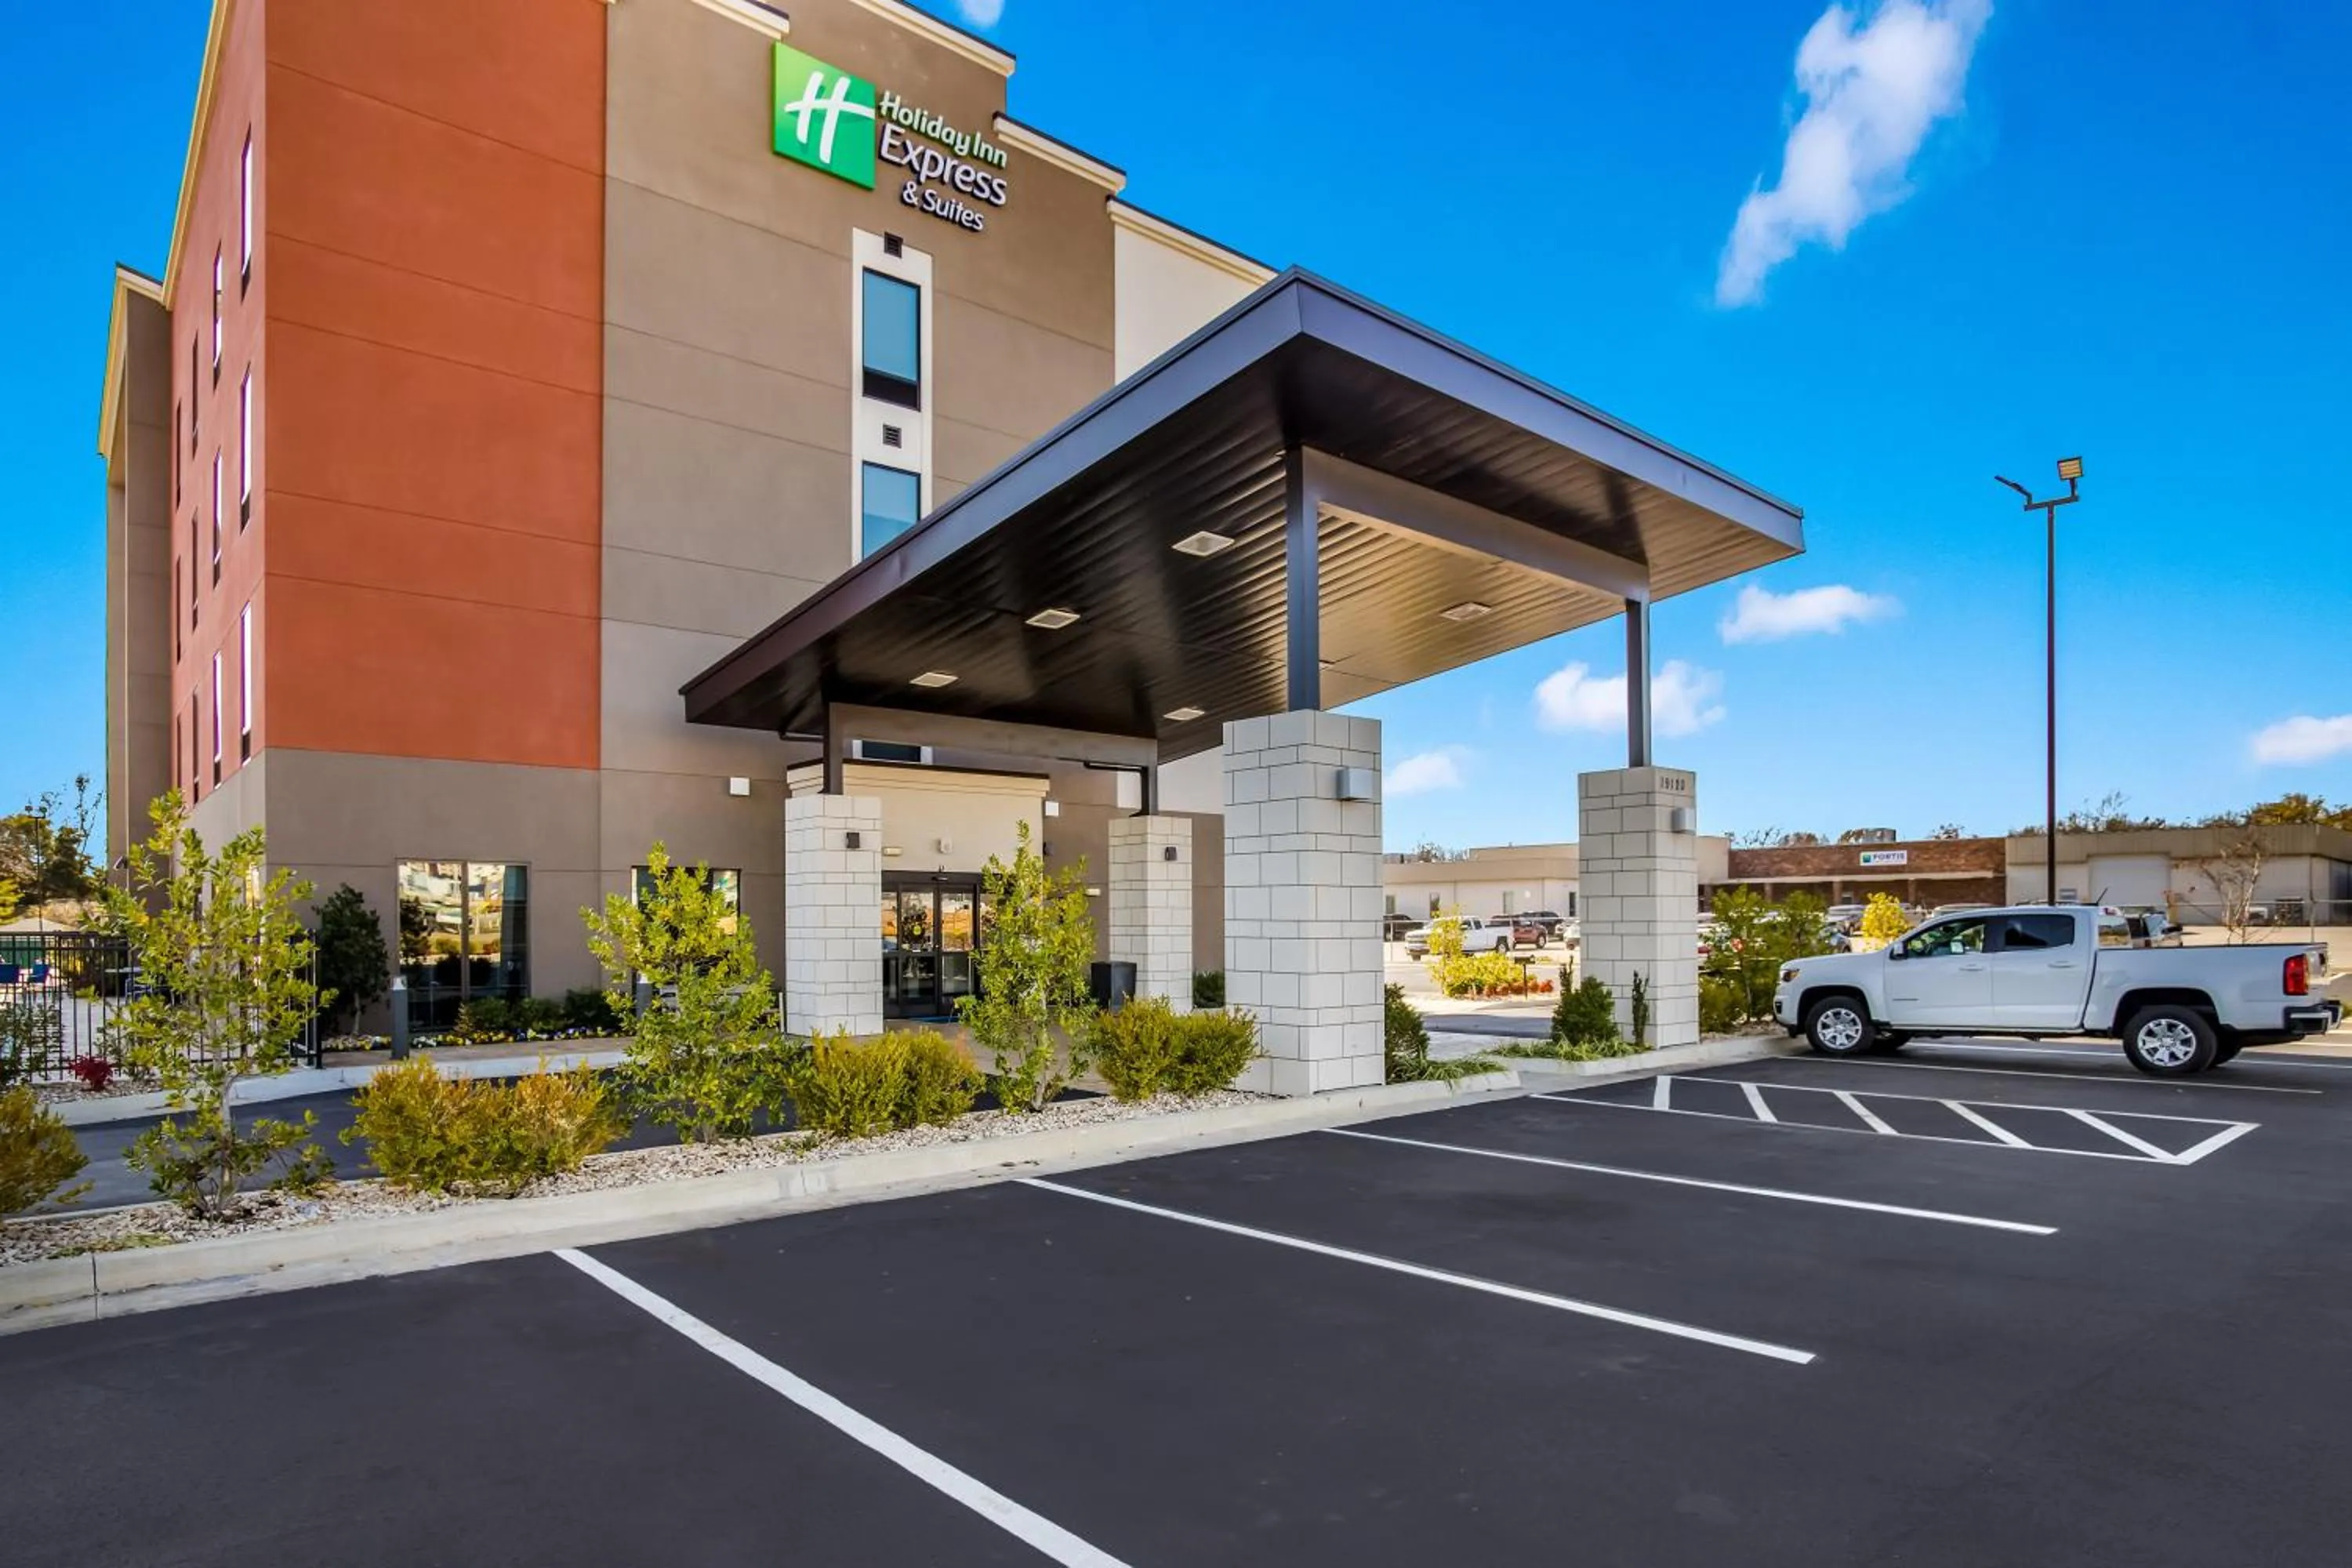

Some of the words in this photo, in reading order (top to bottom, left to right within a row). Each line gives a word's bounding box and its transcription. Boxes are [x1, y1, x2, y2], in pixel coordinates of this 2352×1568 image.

[879, 90, 971, 157] Holiday
[972, 132, 1007, 169] Inn
[880, 123, 1007, 206] Express
[902, 180, 919, 206] &
[922, 190, 985, 232] Suites
